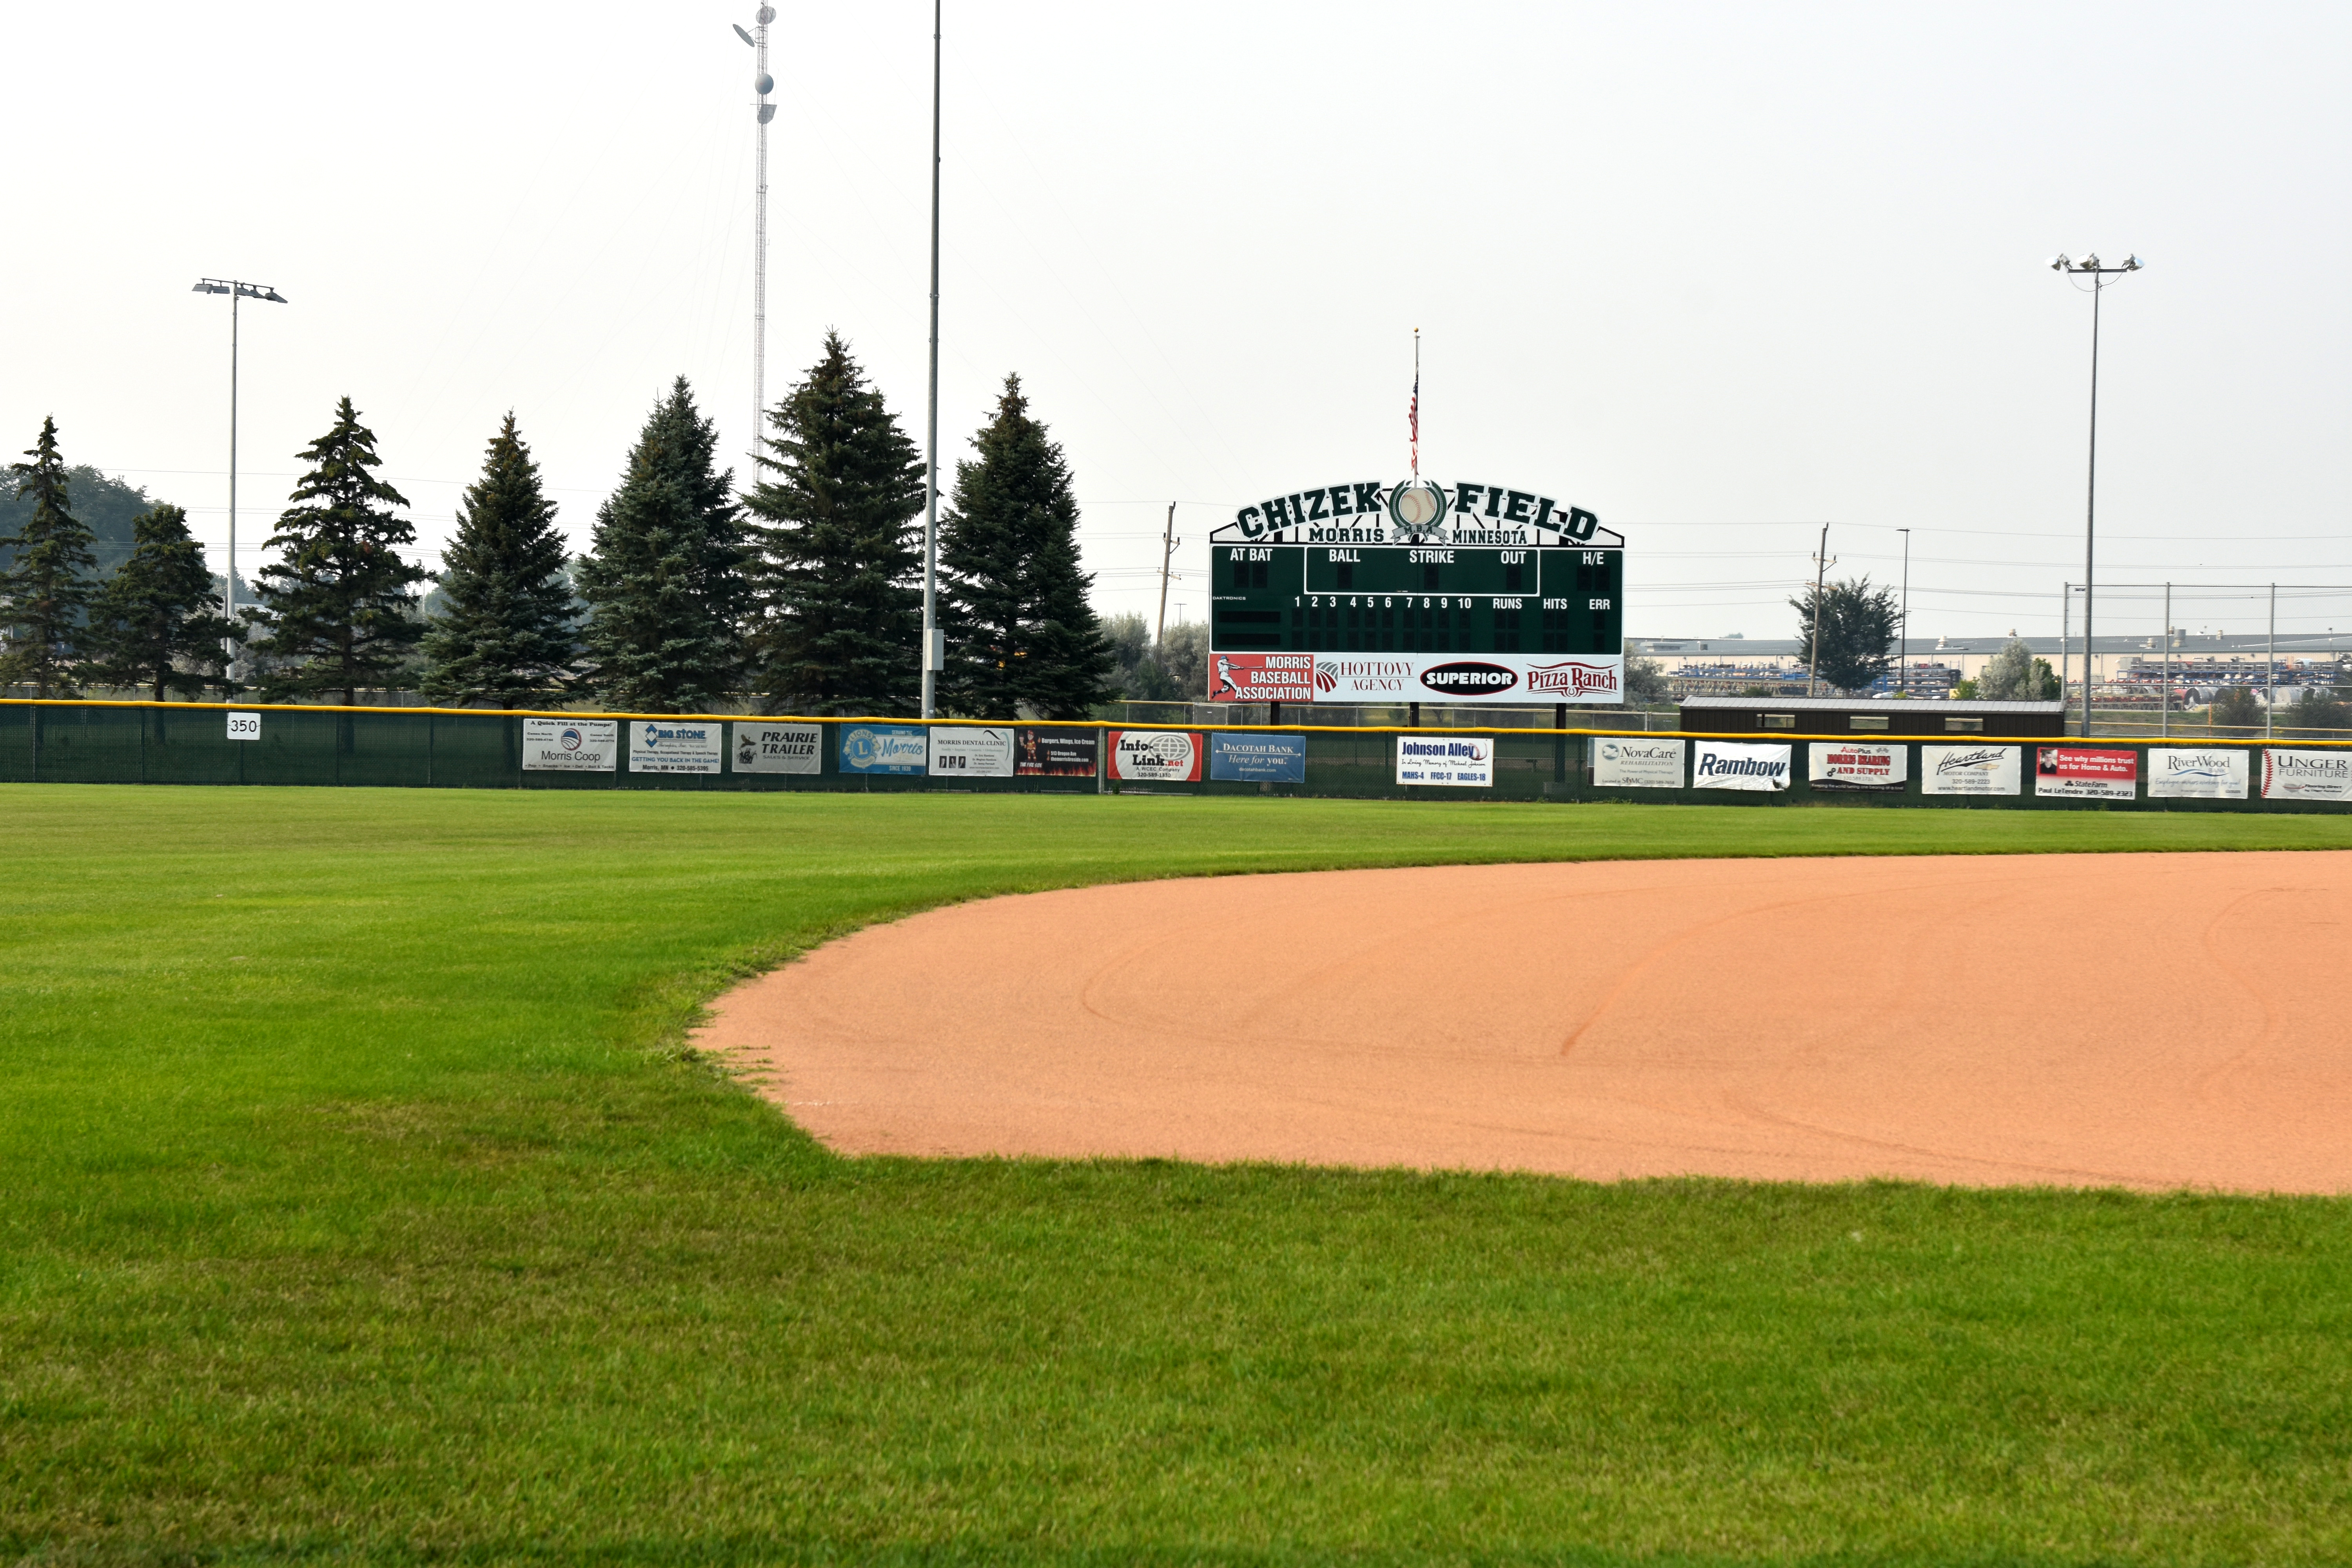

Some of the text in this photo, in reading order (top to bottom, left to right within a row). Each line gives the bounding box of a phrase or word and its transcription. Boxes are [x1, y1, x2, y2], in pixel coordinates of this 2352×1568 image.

[1237, 482, 1598, 541] CHIZEK FIELD
[1309, 528, 1384, 542] MORRIS
[1403, 526, 1436, 534] M.B.A.
[1453, 530, 1527, 544] MINNESOTA
[1230, 548, 1272, 561] AT BAT
[1329, 549, 1360, 562] BALL
[1409, 550, 1454, 563] STRIKE
[1501, 551, 1526, 564] OUT
[1583, 552, 1604, 564] H/E
[1295, 596, 1471, 608] 1 2 3 4 5 6 7 8 9 10
[1493, 598, 1522, 609] RUNS
[1544, 599, 1567, 609] HITS
[1589, 599, 1610, 610] ERR
[1266, 657, 1310, 669] MORRIS
[1341, 662, 1414, 676] HOTTOVY
[1251, 671, 1310, 684] BASEBALL
[1426, 673, 1512, 684] SUPERIOR
[1527, 668, 1617, 690] Pizza Ranch
[1352, 679, 1404, 691] AGENCY
[1235, 687, 1310, 699] ASSOCIATION
[231, 720, 256, 732] 350
[658, 729, 705, 739] BIG STONE
[761, 732, 818, 742] PRAIRIE
[850, 730, 872, 739] LIONS
[762, 744, 815, 754] TRAILER
[858, 741, 868, 755] L
[881, 738, 924, 757] Morris
[1120, 740, 1153, 751] Info-
[1223, 743, 1294, 753] DACOTAH BANK
[1402, 742, 1474, 758] Johnson Alley
[541, 751, 600, 763] Morris Coop
[1621, 746, 1676, 758] NovaCare
[1250, 756, 1264, 765] for
[1267, 758, 1287, 766] you.
[1698, 753, 1786, 776] Rambow
[1936, 748, 2007, 775] Heartland
[2167, 756, 2230, 770] RiverWood
[2278, 755, 2348, 769] UNGER
[2279, 769, 2348, 778] FURNITURE
